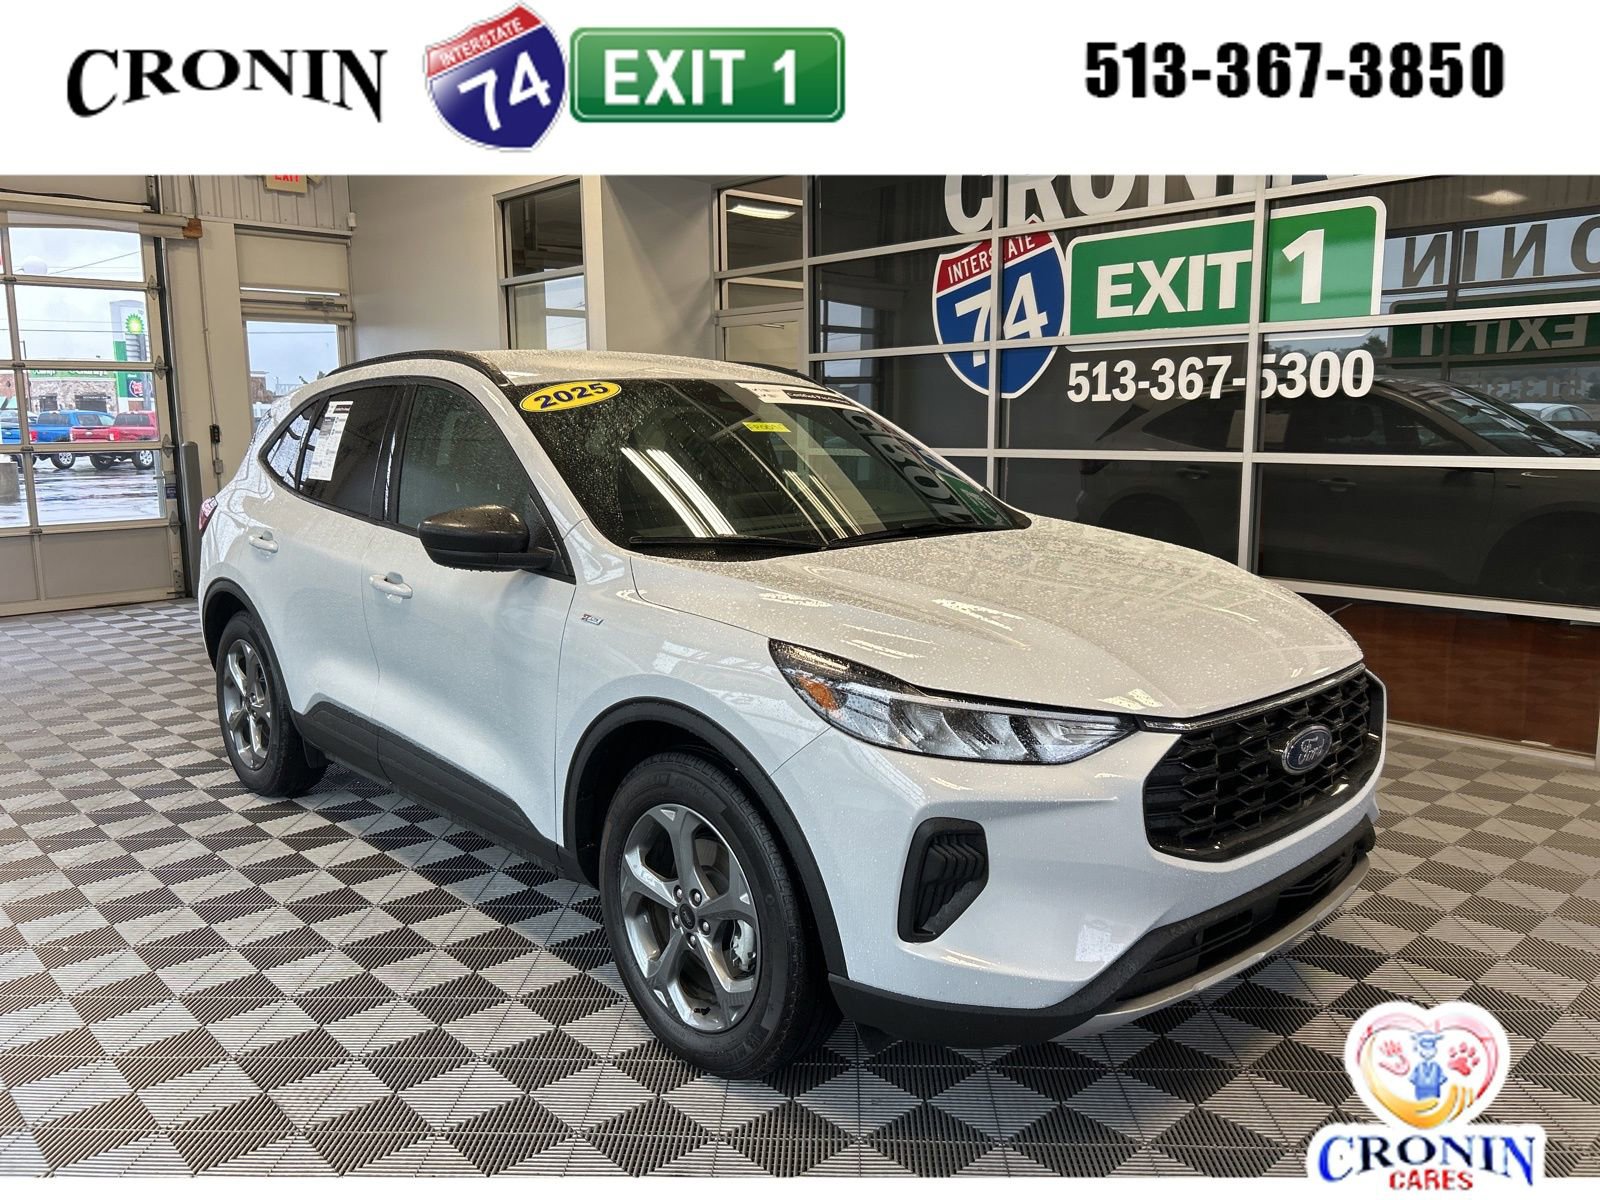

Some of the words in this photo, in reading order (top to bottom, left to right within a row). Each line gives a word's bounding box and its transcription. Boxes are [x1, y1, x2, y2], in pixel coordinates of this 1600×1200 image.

[1097, 249, 1252, 319] EXIT
[1282, 229, 1325, 304] 1
[955, 272, 1049, 367] 74
[533, 383, 609, 409] 2025
[1067, 350, 1375, 402] 513-367-5300
[1298, 735, 1325, 765] Ford
